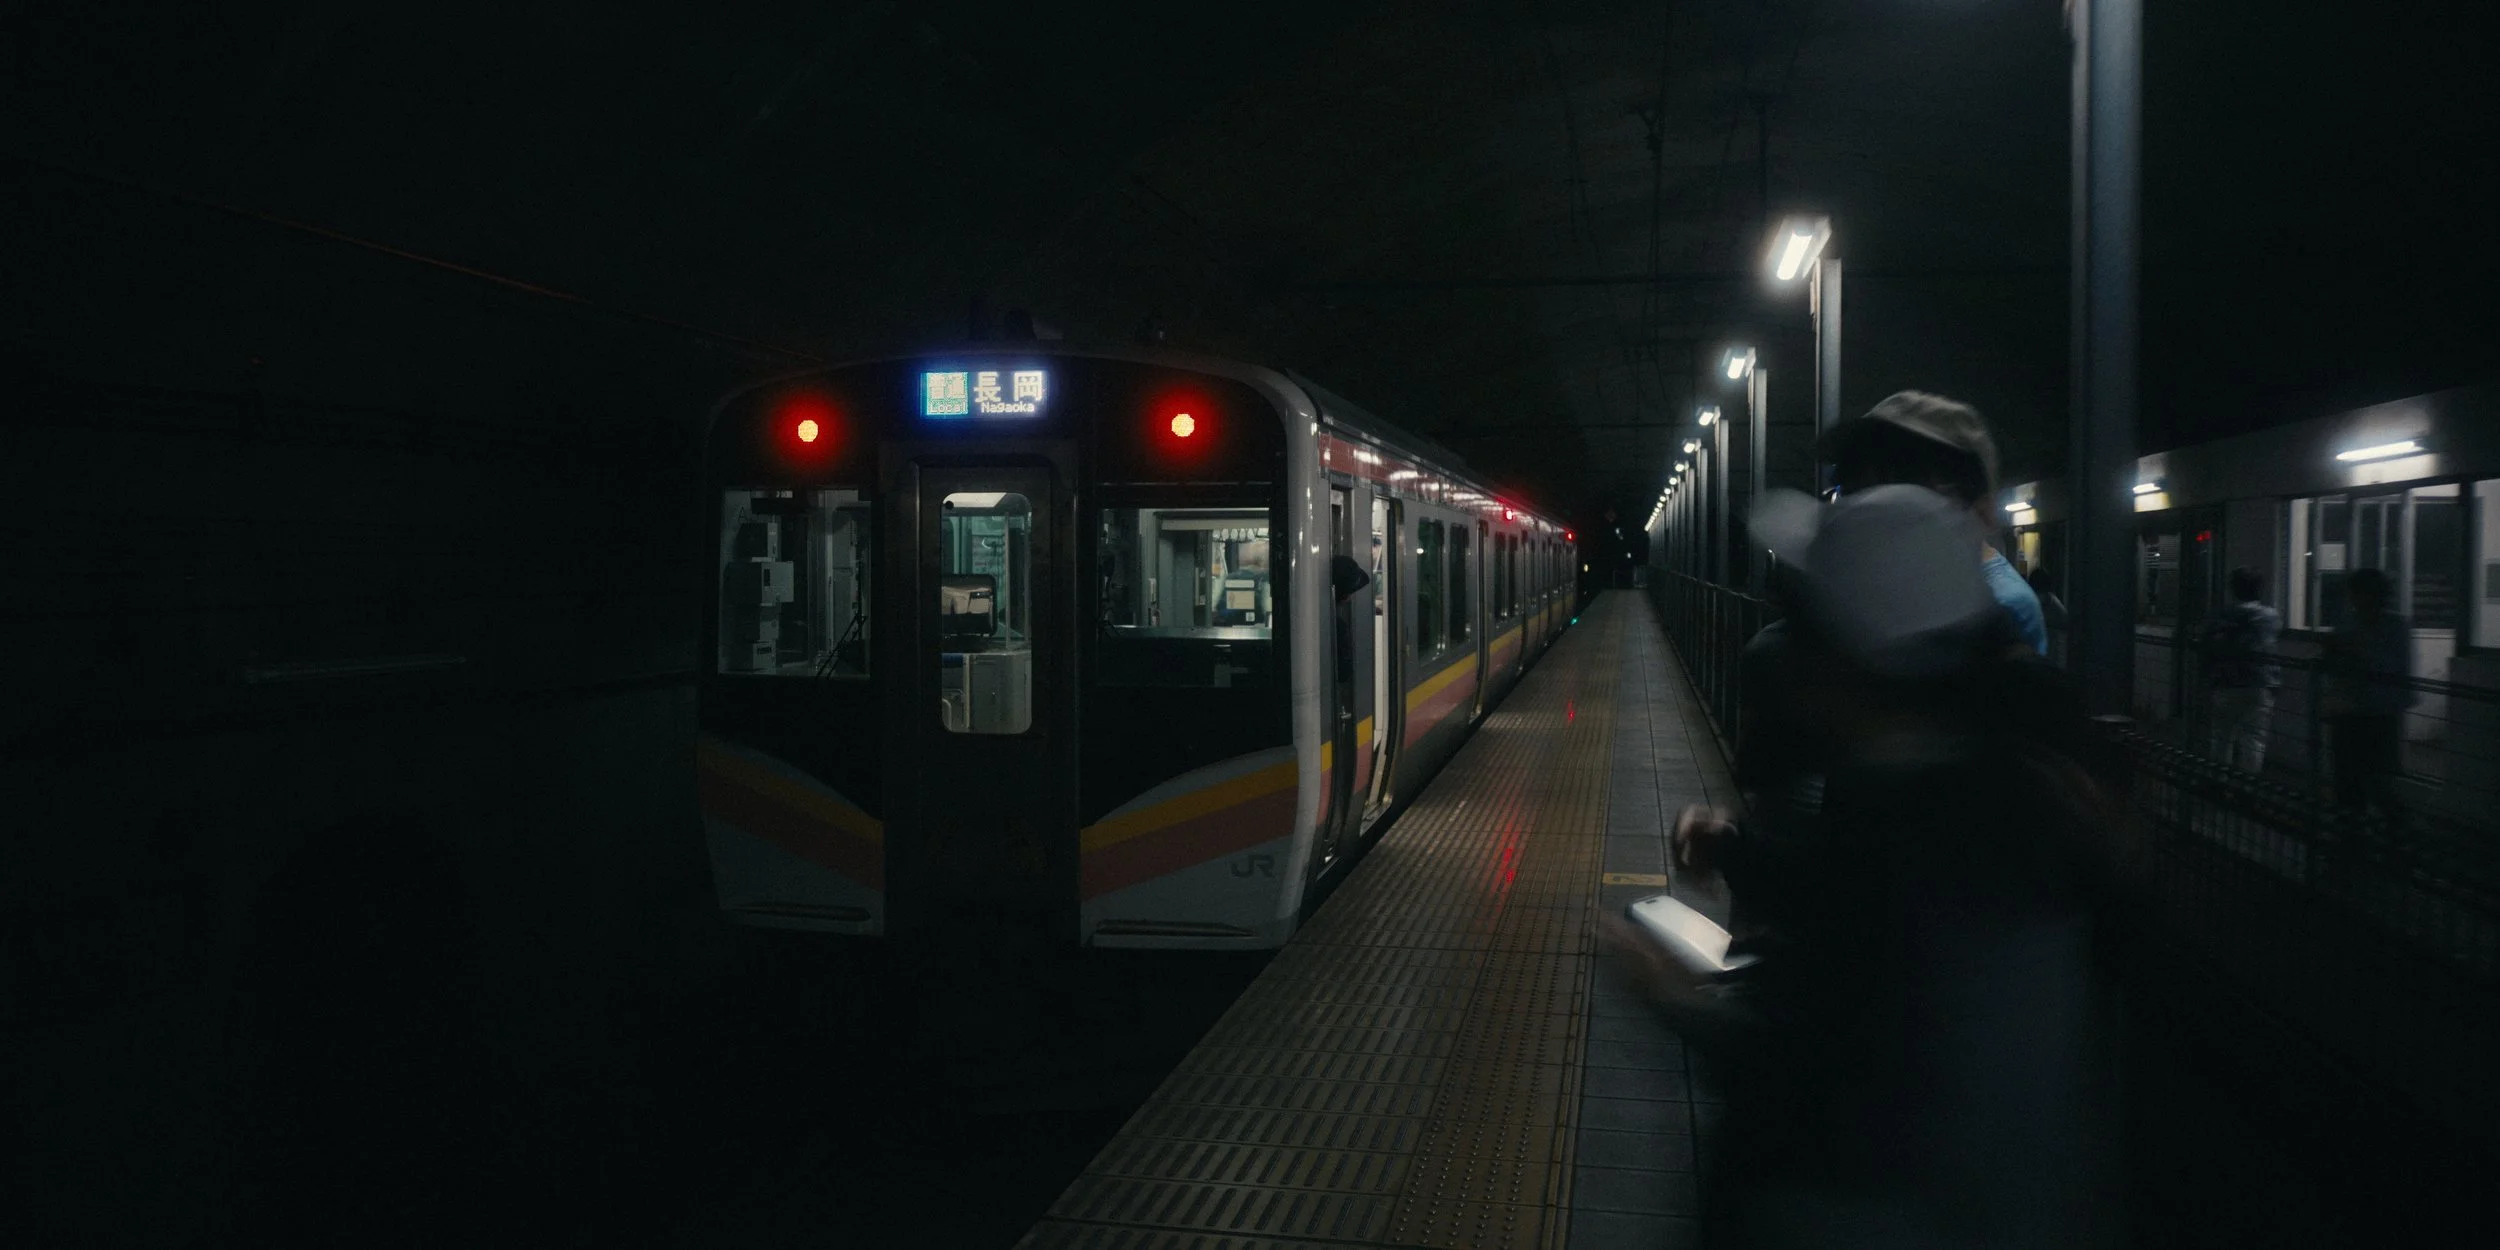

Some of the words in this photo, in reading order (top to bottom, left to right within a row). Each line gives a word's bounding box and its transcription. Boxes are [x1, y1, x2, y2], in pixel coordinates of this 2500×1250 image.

[973, 371, 1043, 402] 長岡
[981, 401, 1035, 413] Nagaoka
[1231, 854, 1275, 878] JR
